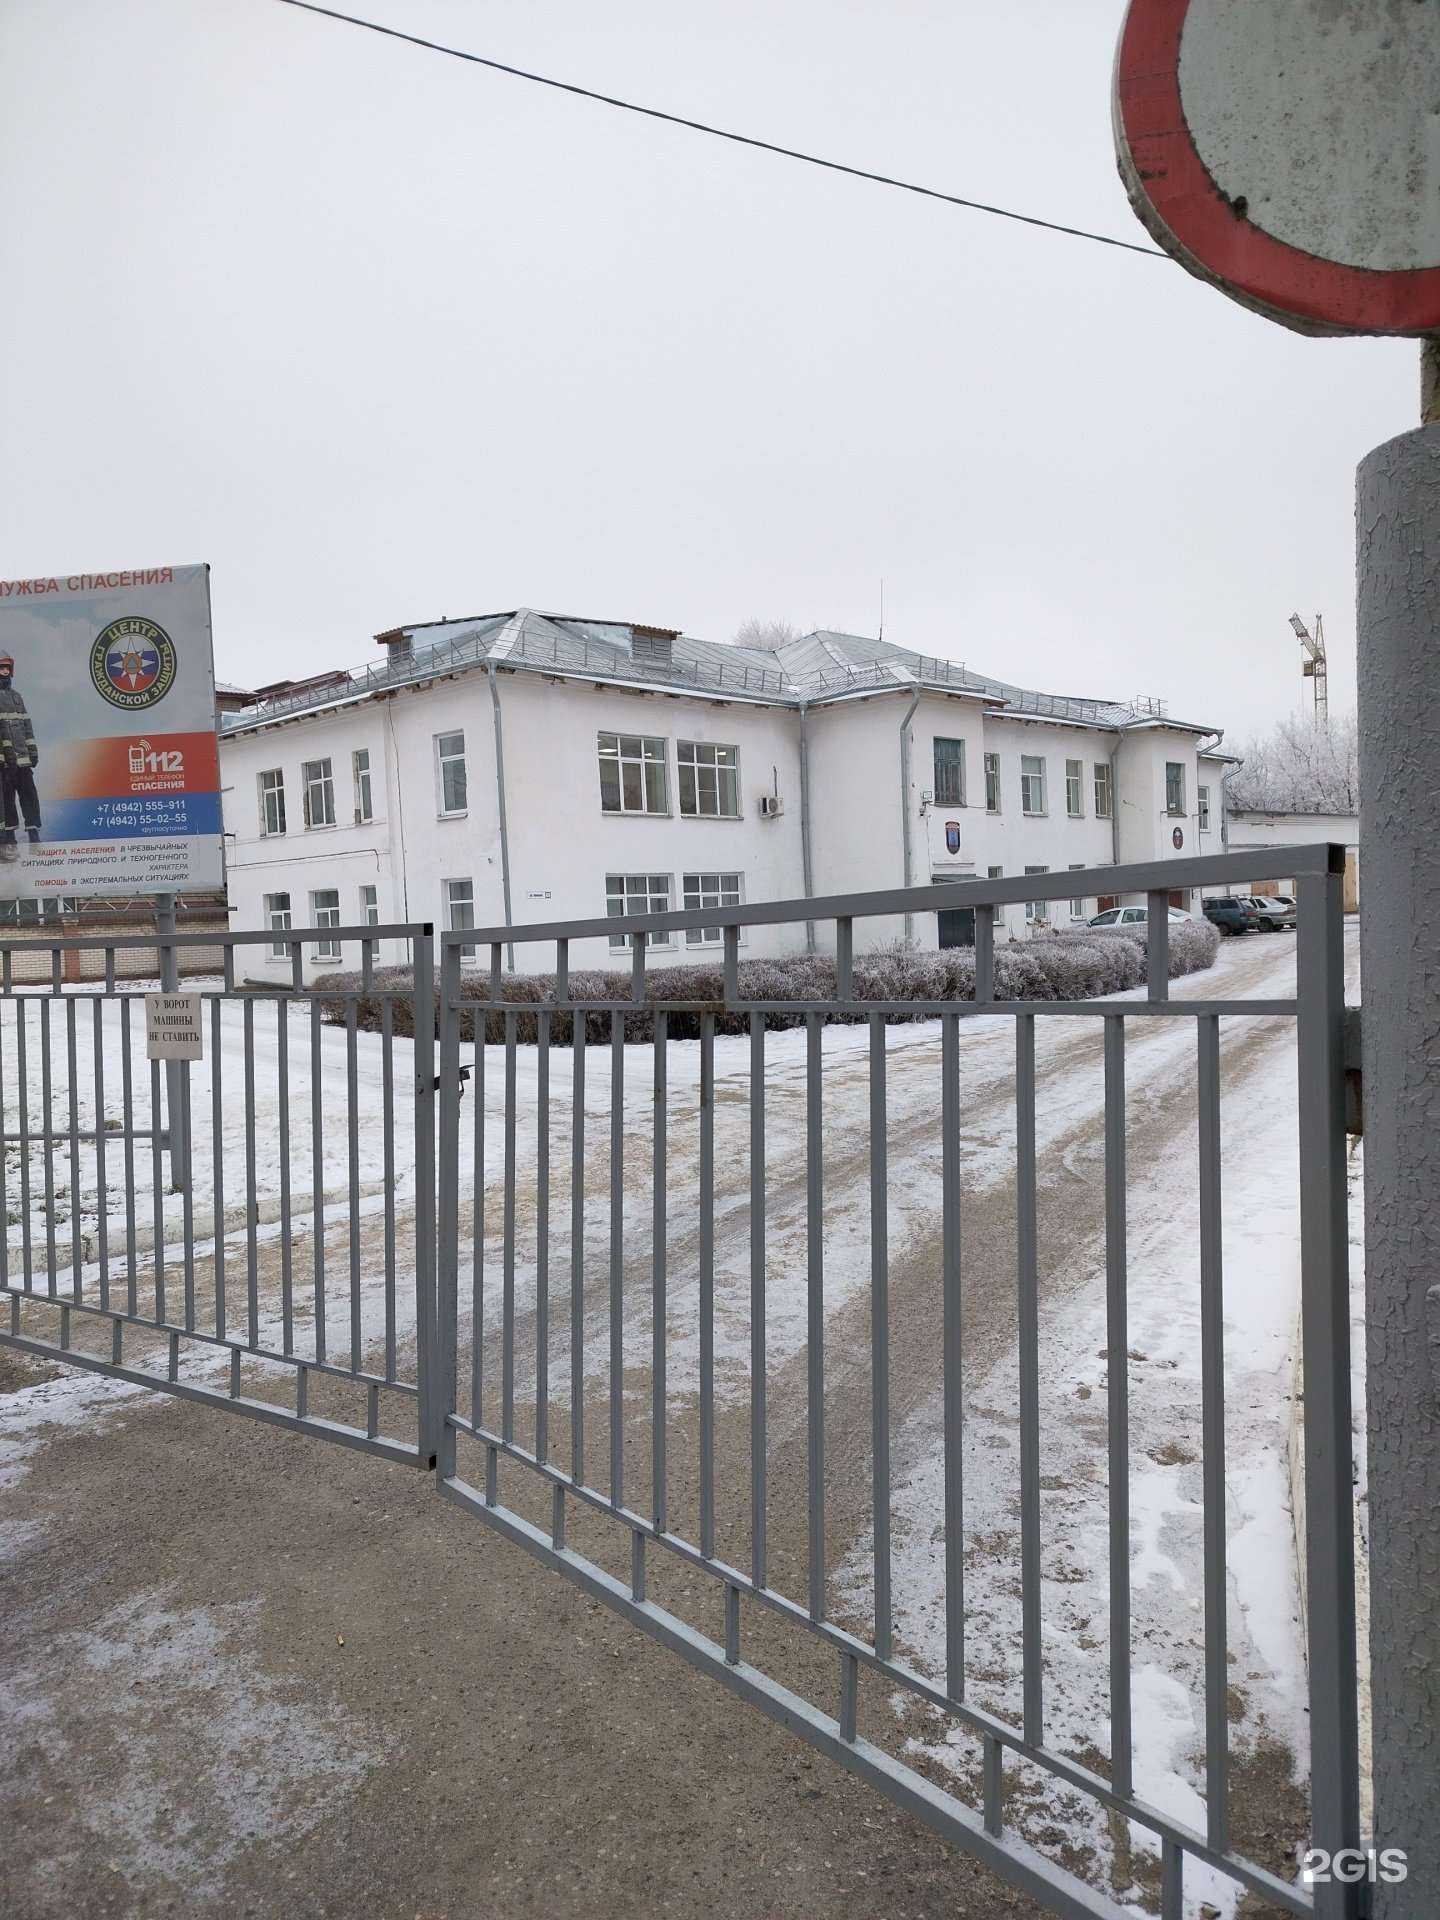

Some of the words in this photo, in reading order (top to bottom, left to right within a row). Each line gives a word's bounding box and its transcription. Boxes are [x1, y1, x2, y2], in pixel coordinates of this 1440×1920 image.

[67, 567, 173, 591] СПАСЕНИЯ
[108, 621, 158, 641] ЦЕНТР
[94, 645, 150, 704] ГРАЖДАНСКОЙ
[151, 643, 173, 696] ЗАЩИТЫ
[145, 751, 184, 772] 112
[131, 780, 185, 791] СПАСЕНИЯ
[97, 803, 109, 813] +7
[112, 802, 142, 814] (4942)
[91, 817, 103, 826] +7
[106, 815, 137, 827] (4942)
[36, 848, 67, 857] ЗАЩИТА
[71, 847, 115, 855] НАСЕЛЕНИЯ
[127, 842, 188, 852] ЧРЕЗВЫЧАЙНЫХ
[22, 859, 65, 868] СИТУАЦИЯХ
[68, 857, 117, 865] ПРИРОДНОГО
[130, 853, 188, 862] ТЕХНОГЕННОГО
[34, 879, 68, 887] ПОМОЩЬ
[80, 875, 143, 885] ЭКСТРЕМАЛЬНЫХ
[145, 873, 189, 882] СИТУАЦИЯХ
[154, 1000, 159, 1009] У
[164, 1000, 190, 1009] ВОРОТ
[153, 1016, 193, 1025] МАШИНЫ
[149, 1032, 159, 1041] НЕ
[162, 1032, 199, 1042] СТАВИТЬ
